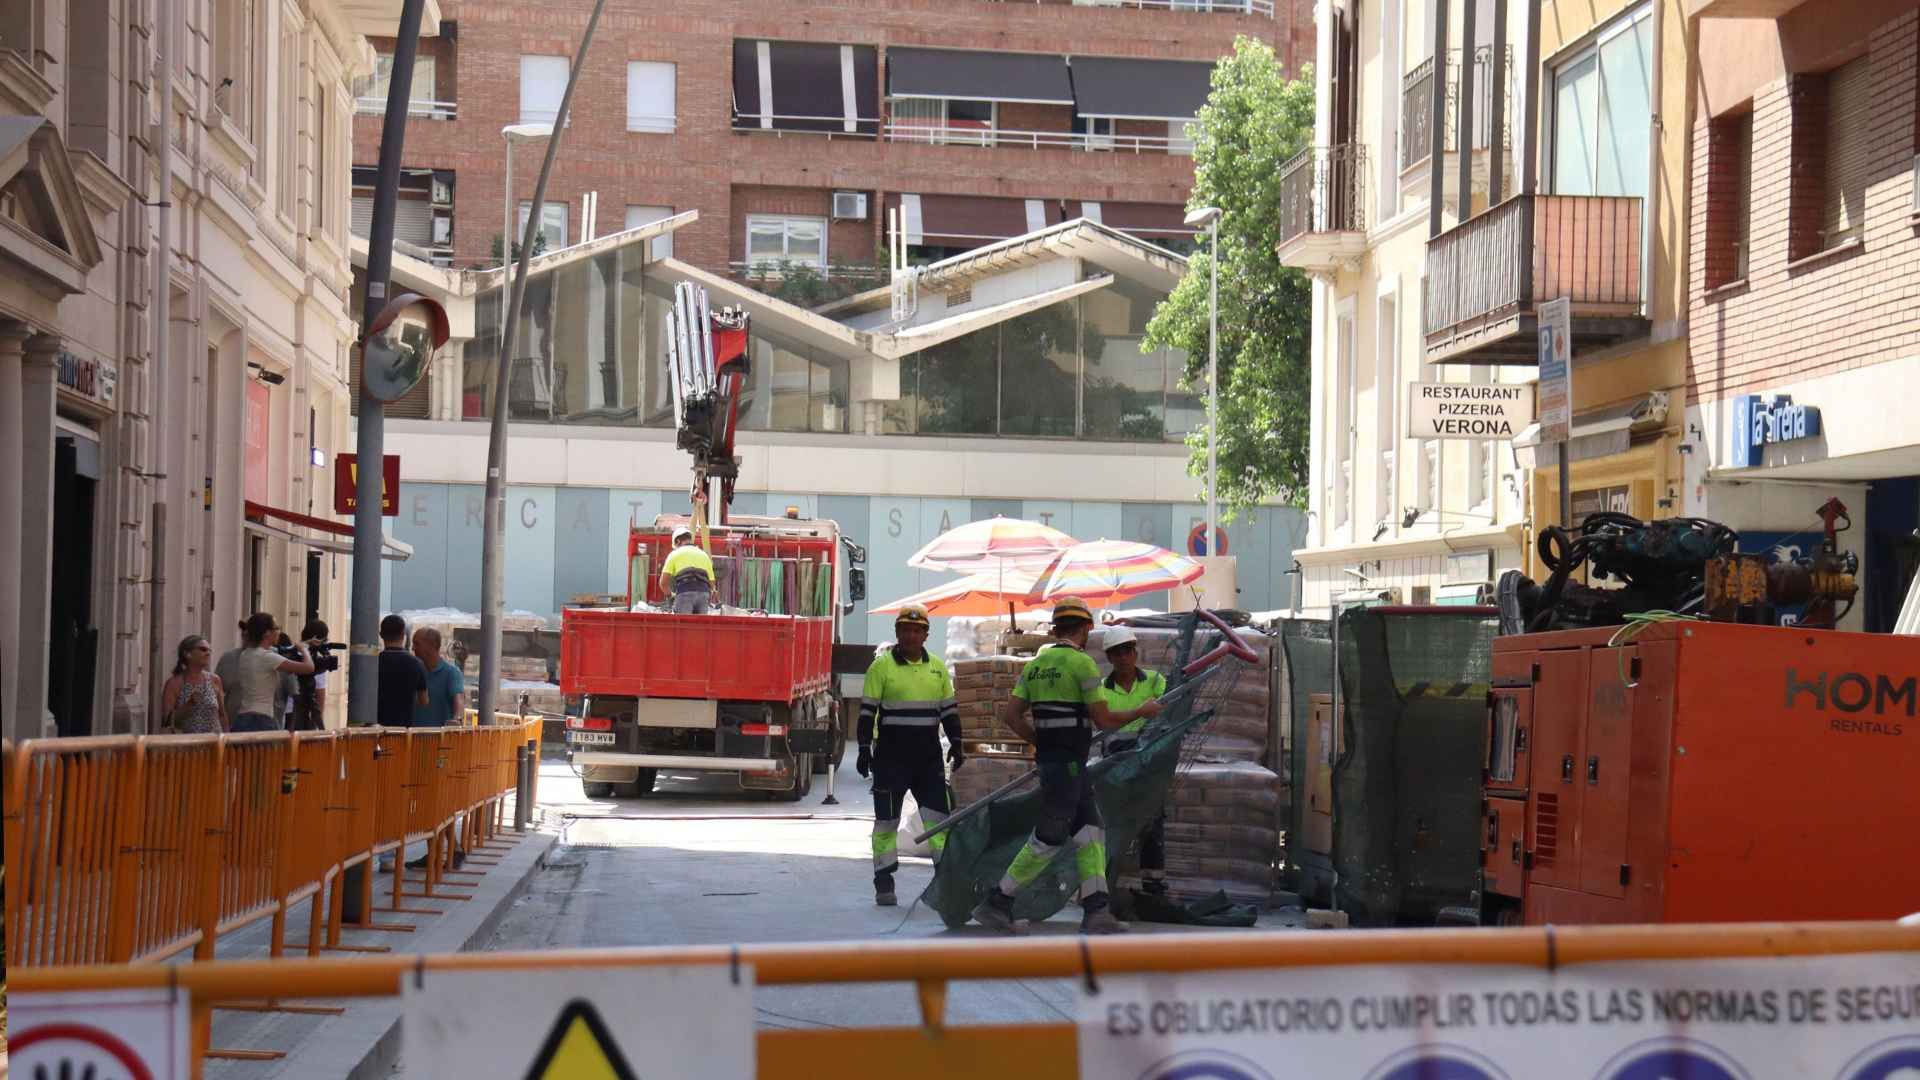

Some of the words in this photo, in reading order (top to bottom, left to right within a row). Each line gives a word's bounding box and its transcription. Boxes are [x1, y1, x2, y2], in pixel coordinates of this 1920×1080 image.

[1422, 386, 1522, 400] RESTAURANT
[1439, 403, 1505, 416] PIZZERIA
[1432, 419, 1513, 434] VERONA
[1765, 400, 1806, 444] Sirena
[1785, 667, 1916, 716] HOM
[1831, 719, 1903, 737] RENTALS
[1107, 1001, 1144, 1035] ES
[1151, 1000, 1343, 1034] OBLIGATORIO
[1350, 995, 1475, 1030] CUMPLIR
[1486, 990, 1580, 1026] TODAS
[1588, 989, 1645, 1024] LAS
[1653, 988, 1778, 1024] NORMAS
[1789, 987, 1827, 1022] DE
